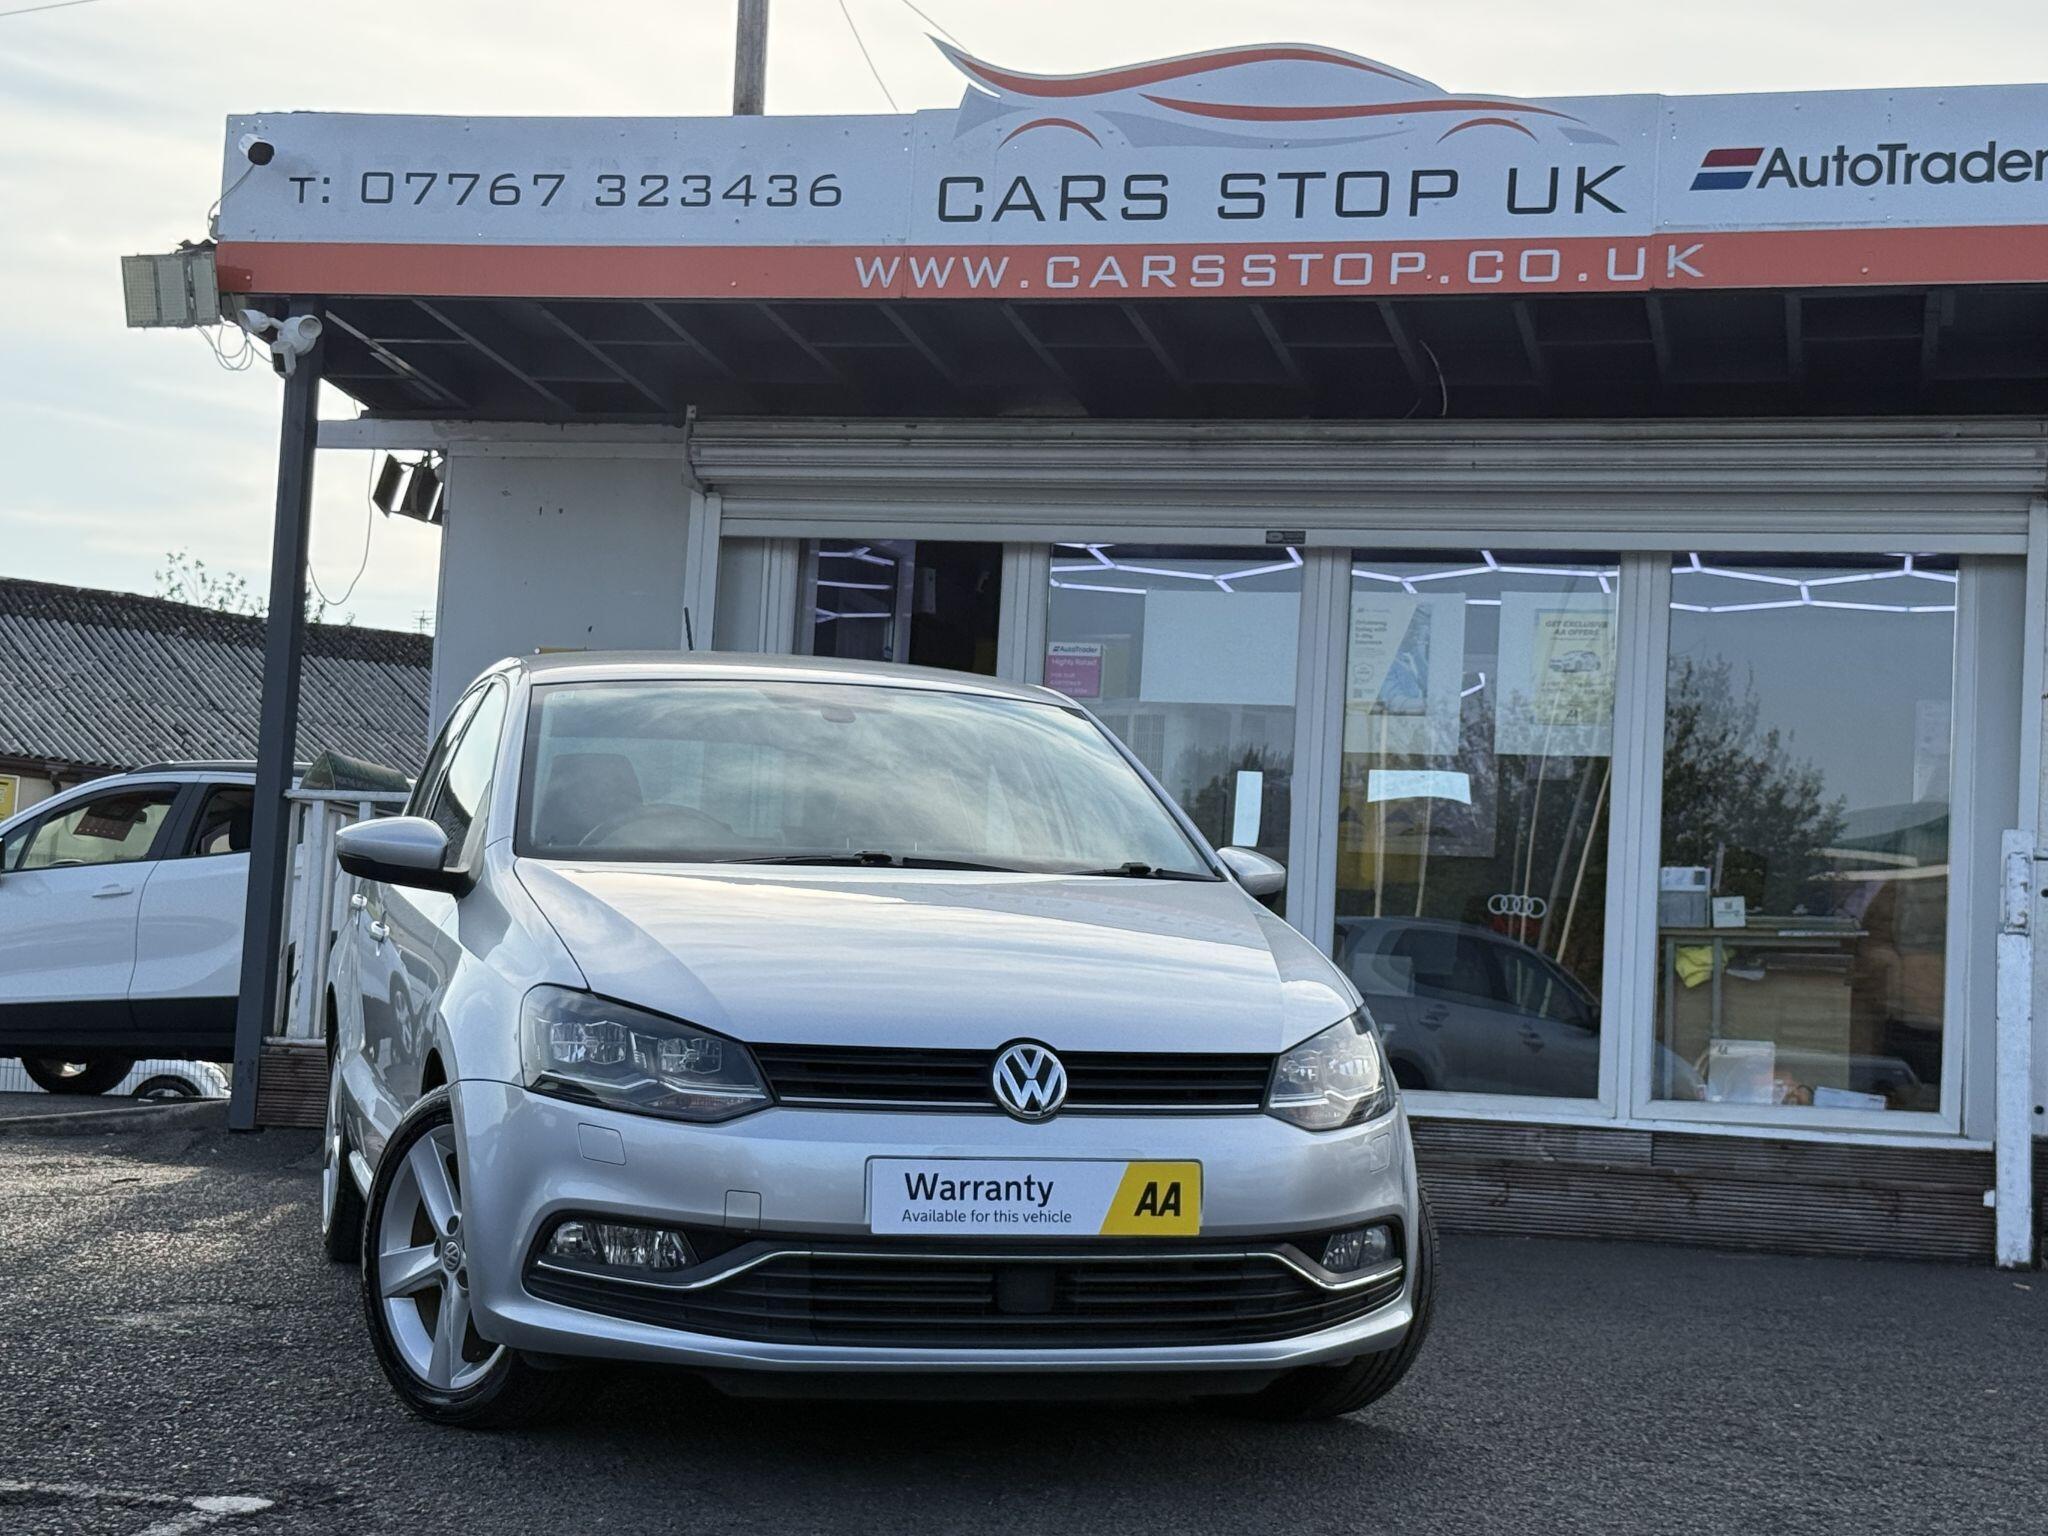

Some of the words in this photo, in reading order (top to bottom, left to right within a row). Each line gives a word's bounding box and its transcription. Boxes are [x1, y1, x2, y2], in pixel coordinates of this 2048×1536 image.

[1756, 140, 2048, 189] AutoTrader
[289, 176, 331, 204] T:
[360, 171, 566, 207] 07767
[595, 173, 842, 207] 323436
[937, 173, 1169, 223] CARS
[1217, 169, 1459, 220] STOP
[1506, 164, 1627, 215] UK
[855, 243, 1705, 288] WWW.CARSSTOP.CO.UK
[901, 1208, 967, 1224] Available
[970, 1208, 991, 1224] for
[994, 1209, 1019, 1223] this
[1022, 1209, 1073, 1224] vehicle
[904, 1172, 1055, 1208] Warranty
[1133, 1181, 1182, 1217] AA
